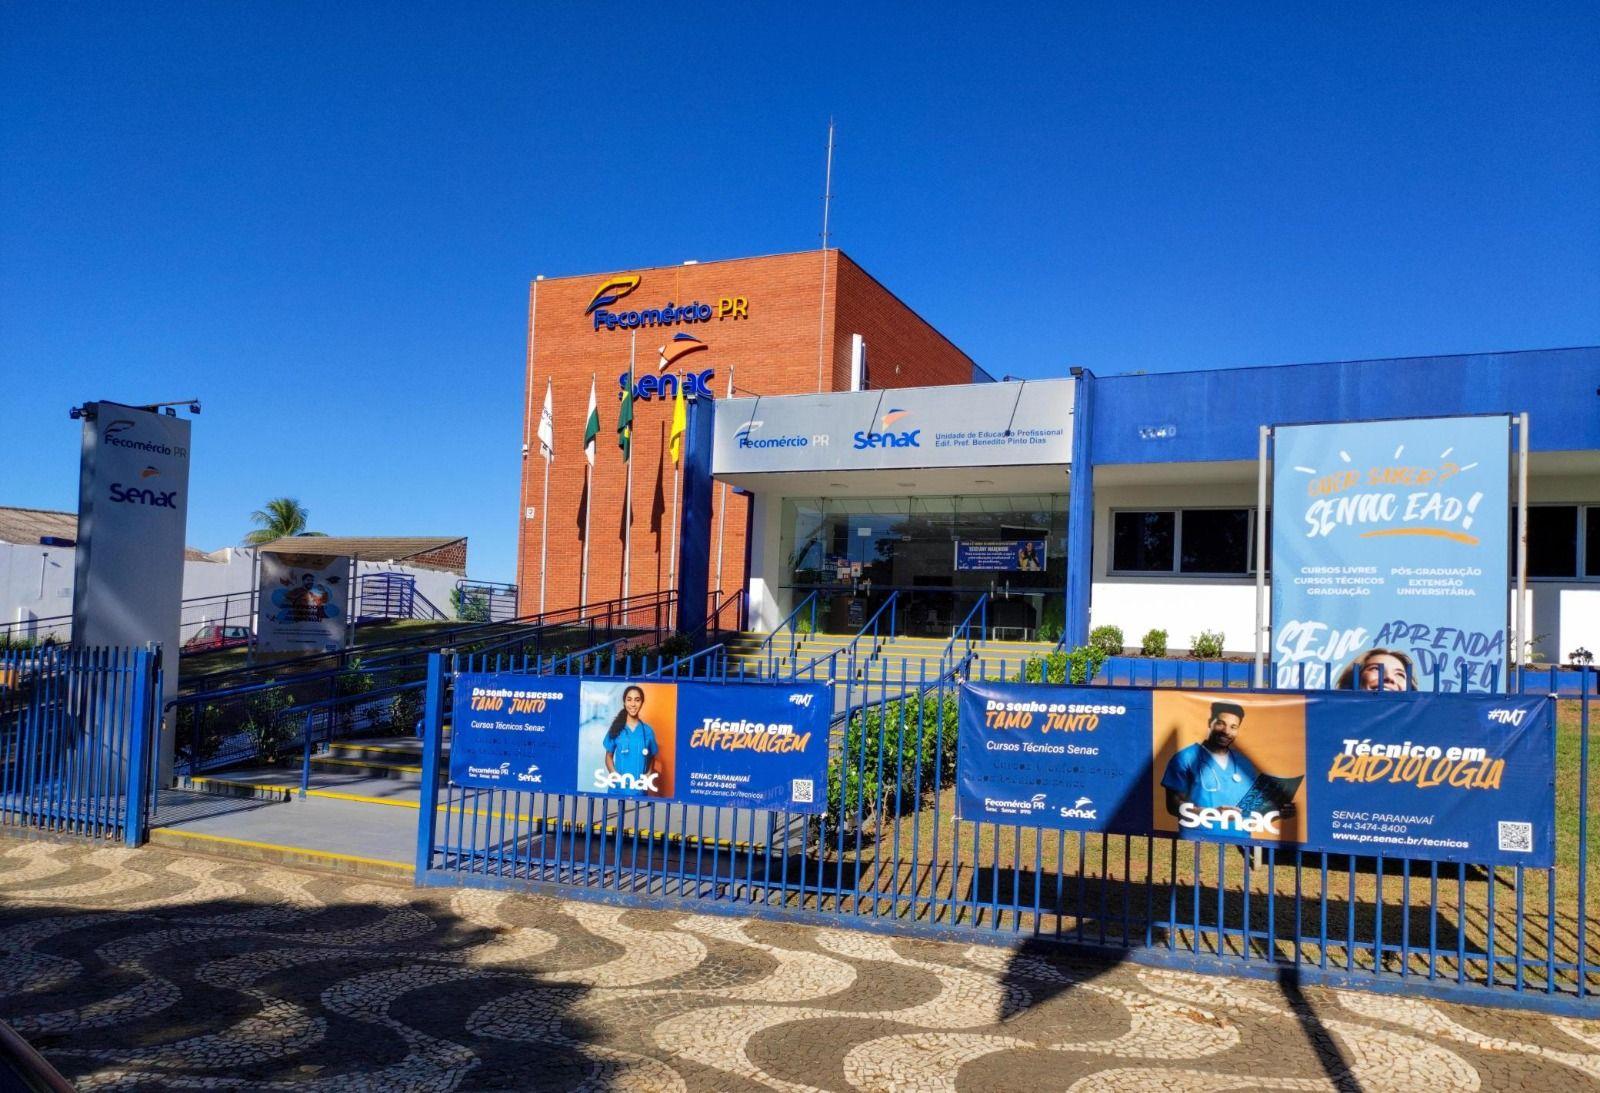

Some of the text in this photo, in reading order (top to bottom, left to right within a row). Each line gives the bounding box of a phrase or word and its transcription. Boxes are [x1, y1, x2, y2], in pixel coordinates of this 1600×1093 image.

[593, 296, 749, 331] Fecomércio PR
[739, 434, 831, 449] Fecomércio PR
[853, 430, 921, 450] Senac
[935, 432, 965, 440] Unidade
[1017, 429, 1063, 437] Profissional
[972, 438, 1005, 446] Benedito
[1007, 437, 1028, 445] Pinto
[1029, 436, 1047, 444] Dias
[104, 434, 187, 458] Fecomércio PR
[109, 482, 177, 510] Senac
[1402, 490, 1485, 531] EAD!
[1299, 565, 1378, 575] CURSOS LIVRES
[1391, 565, 1482, 579] PÓS-GRADUAÇÃO
[1294, 576, 1385, 586] CURSOS TÉCNICOS
[1408, 577, 1464, 588] EXTENSÃO
[1306, 587, 1371, 598] GRADUAÇÃO
[1396, 586, 1477, 597] UNIVERSITÁRIA
[1372, 619, 1504, 657] APRENDA
[1410, 647, 1449, 676] DO
[472, 687, 486, 697] Do
[486, 688, 513, 698] sonho
[525, 690, 564, 700] sucesso
[471, 697, 546, 715] TAMO JUNTO
[986, 700, 1126, 715] Do sonho ao sucesso
[985, 710, 1100, 734] TAMO JUNTO
[1487, 708, 1527, 726] #TMJ
[471, 720, 546, 732] Cursos Técnicos Senac
[702, 717, 794, 736] Técnico em
[689, 729, 812, 753] ENFERMAGEM
[986, 740, 1100, 756] Cursos Técnicos Senac
[1342, 738, 1487, 762] Técnico em
[518, 772, 542, 783] Senac
[690, 772, 713, 781] SENAC
[1327, 752, 1506, 790] RADIOLOGIA
[592, 767, 659, 792] Senac
[984, 798, 1046, 810] Fecomércio PR
[1060, 807, 1097, 820] Senac
[1178, 802, 1280, 836] Senac
[1331, 810, 1436, 825] SENAC PARANAVAÍ
[1354, 822, 1407, 834] 3474-8400
[1332, 831, 1470, 848] www.pr.senac.br/tecnicos
